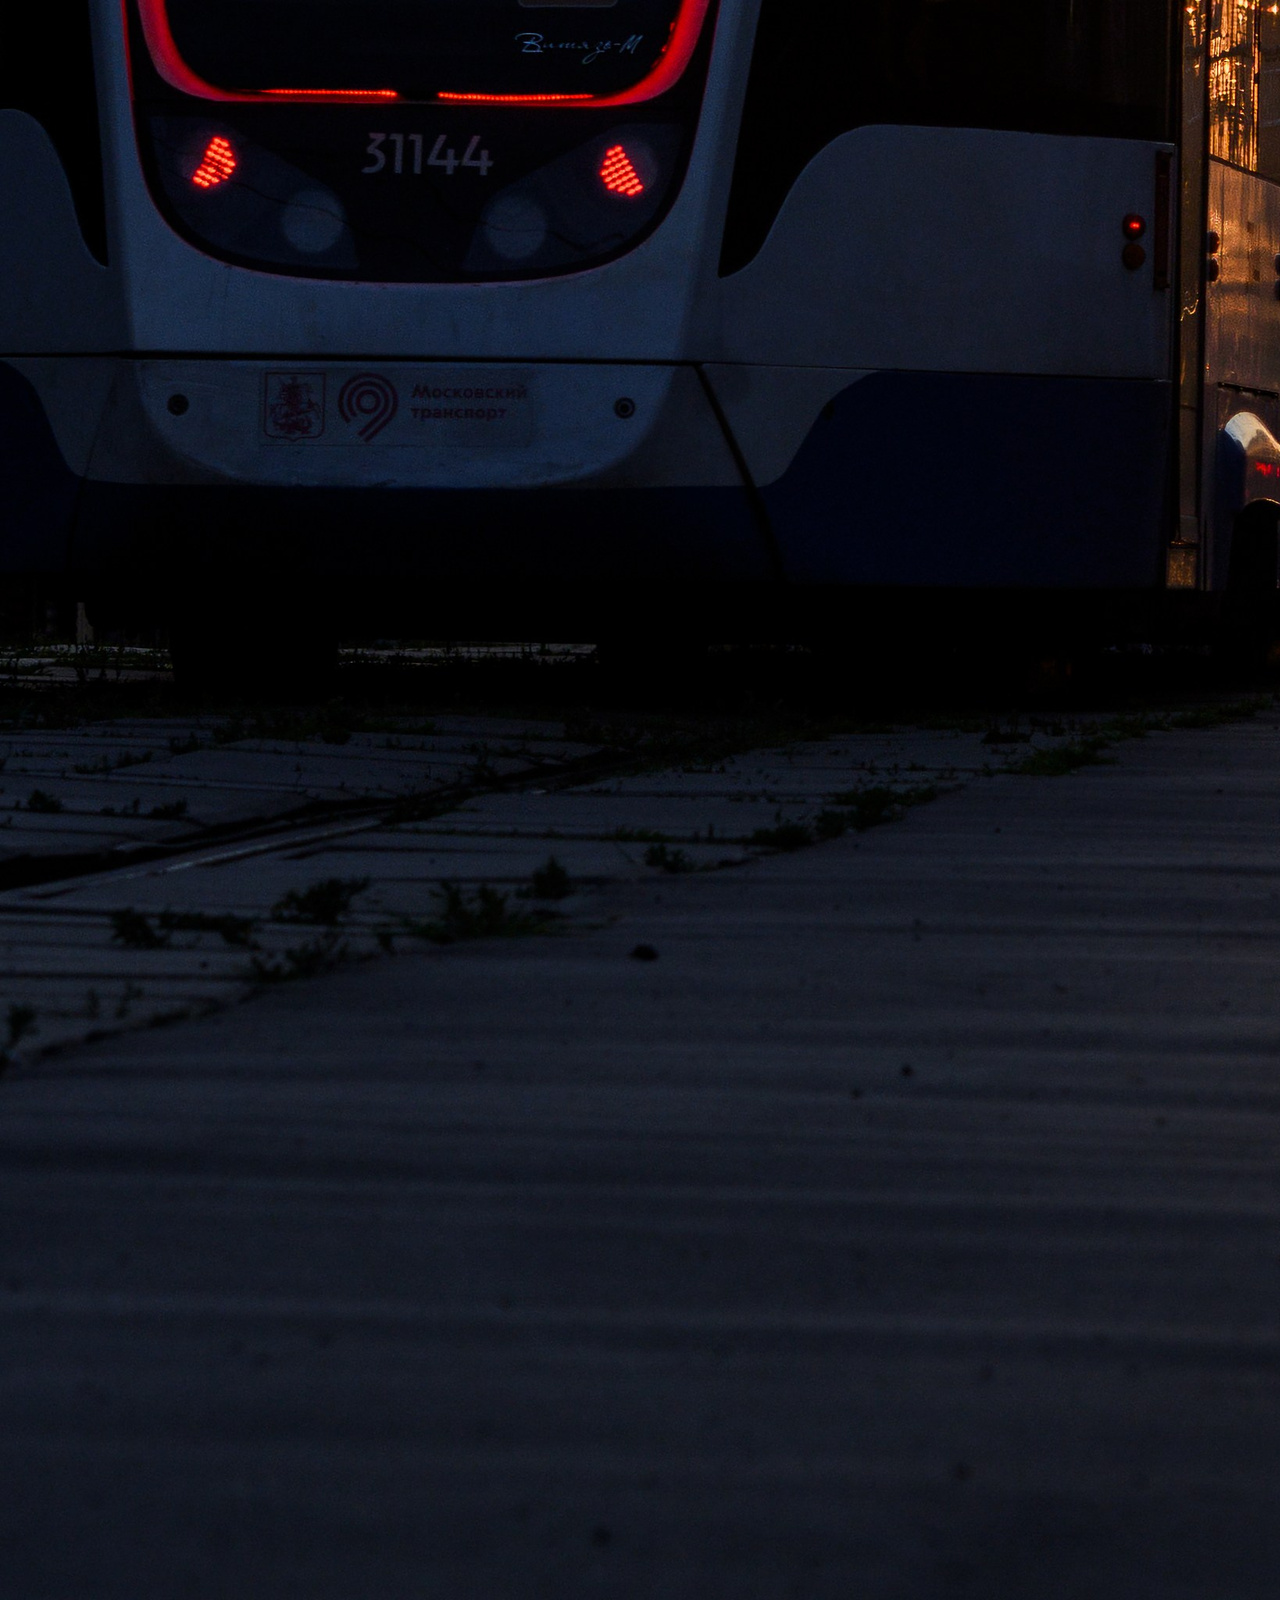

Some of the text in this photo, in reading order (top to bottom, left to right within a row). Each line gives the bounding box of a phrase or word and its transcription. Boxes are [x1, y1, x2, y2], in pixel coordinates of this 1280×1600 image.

[361, 131, 494, 176] 31144
[411, 383, 528, 399] Московский
[411, 408, 507, 421] транспорт
